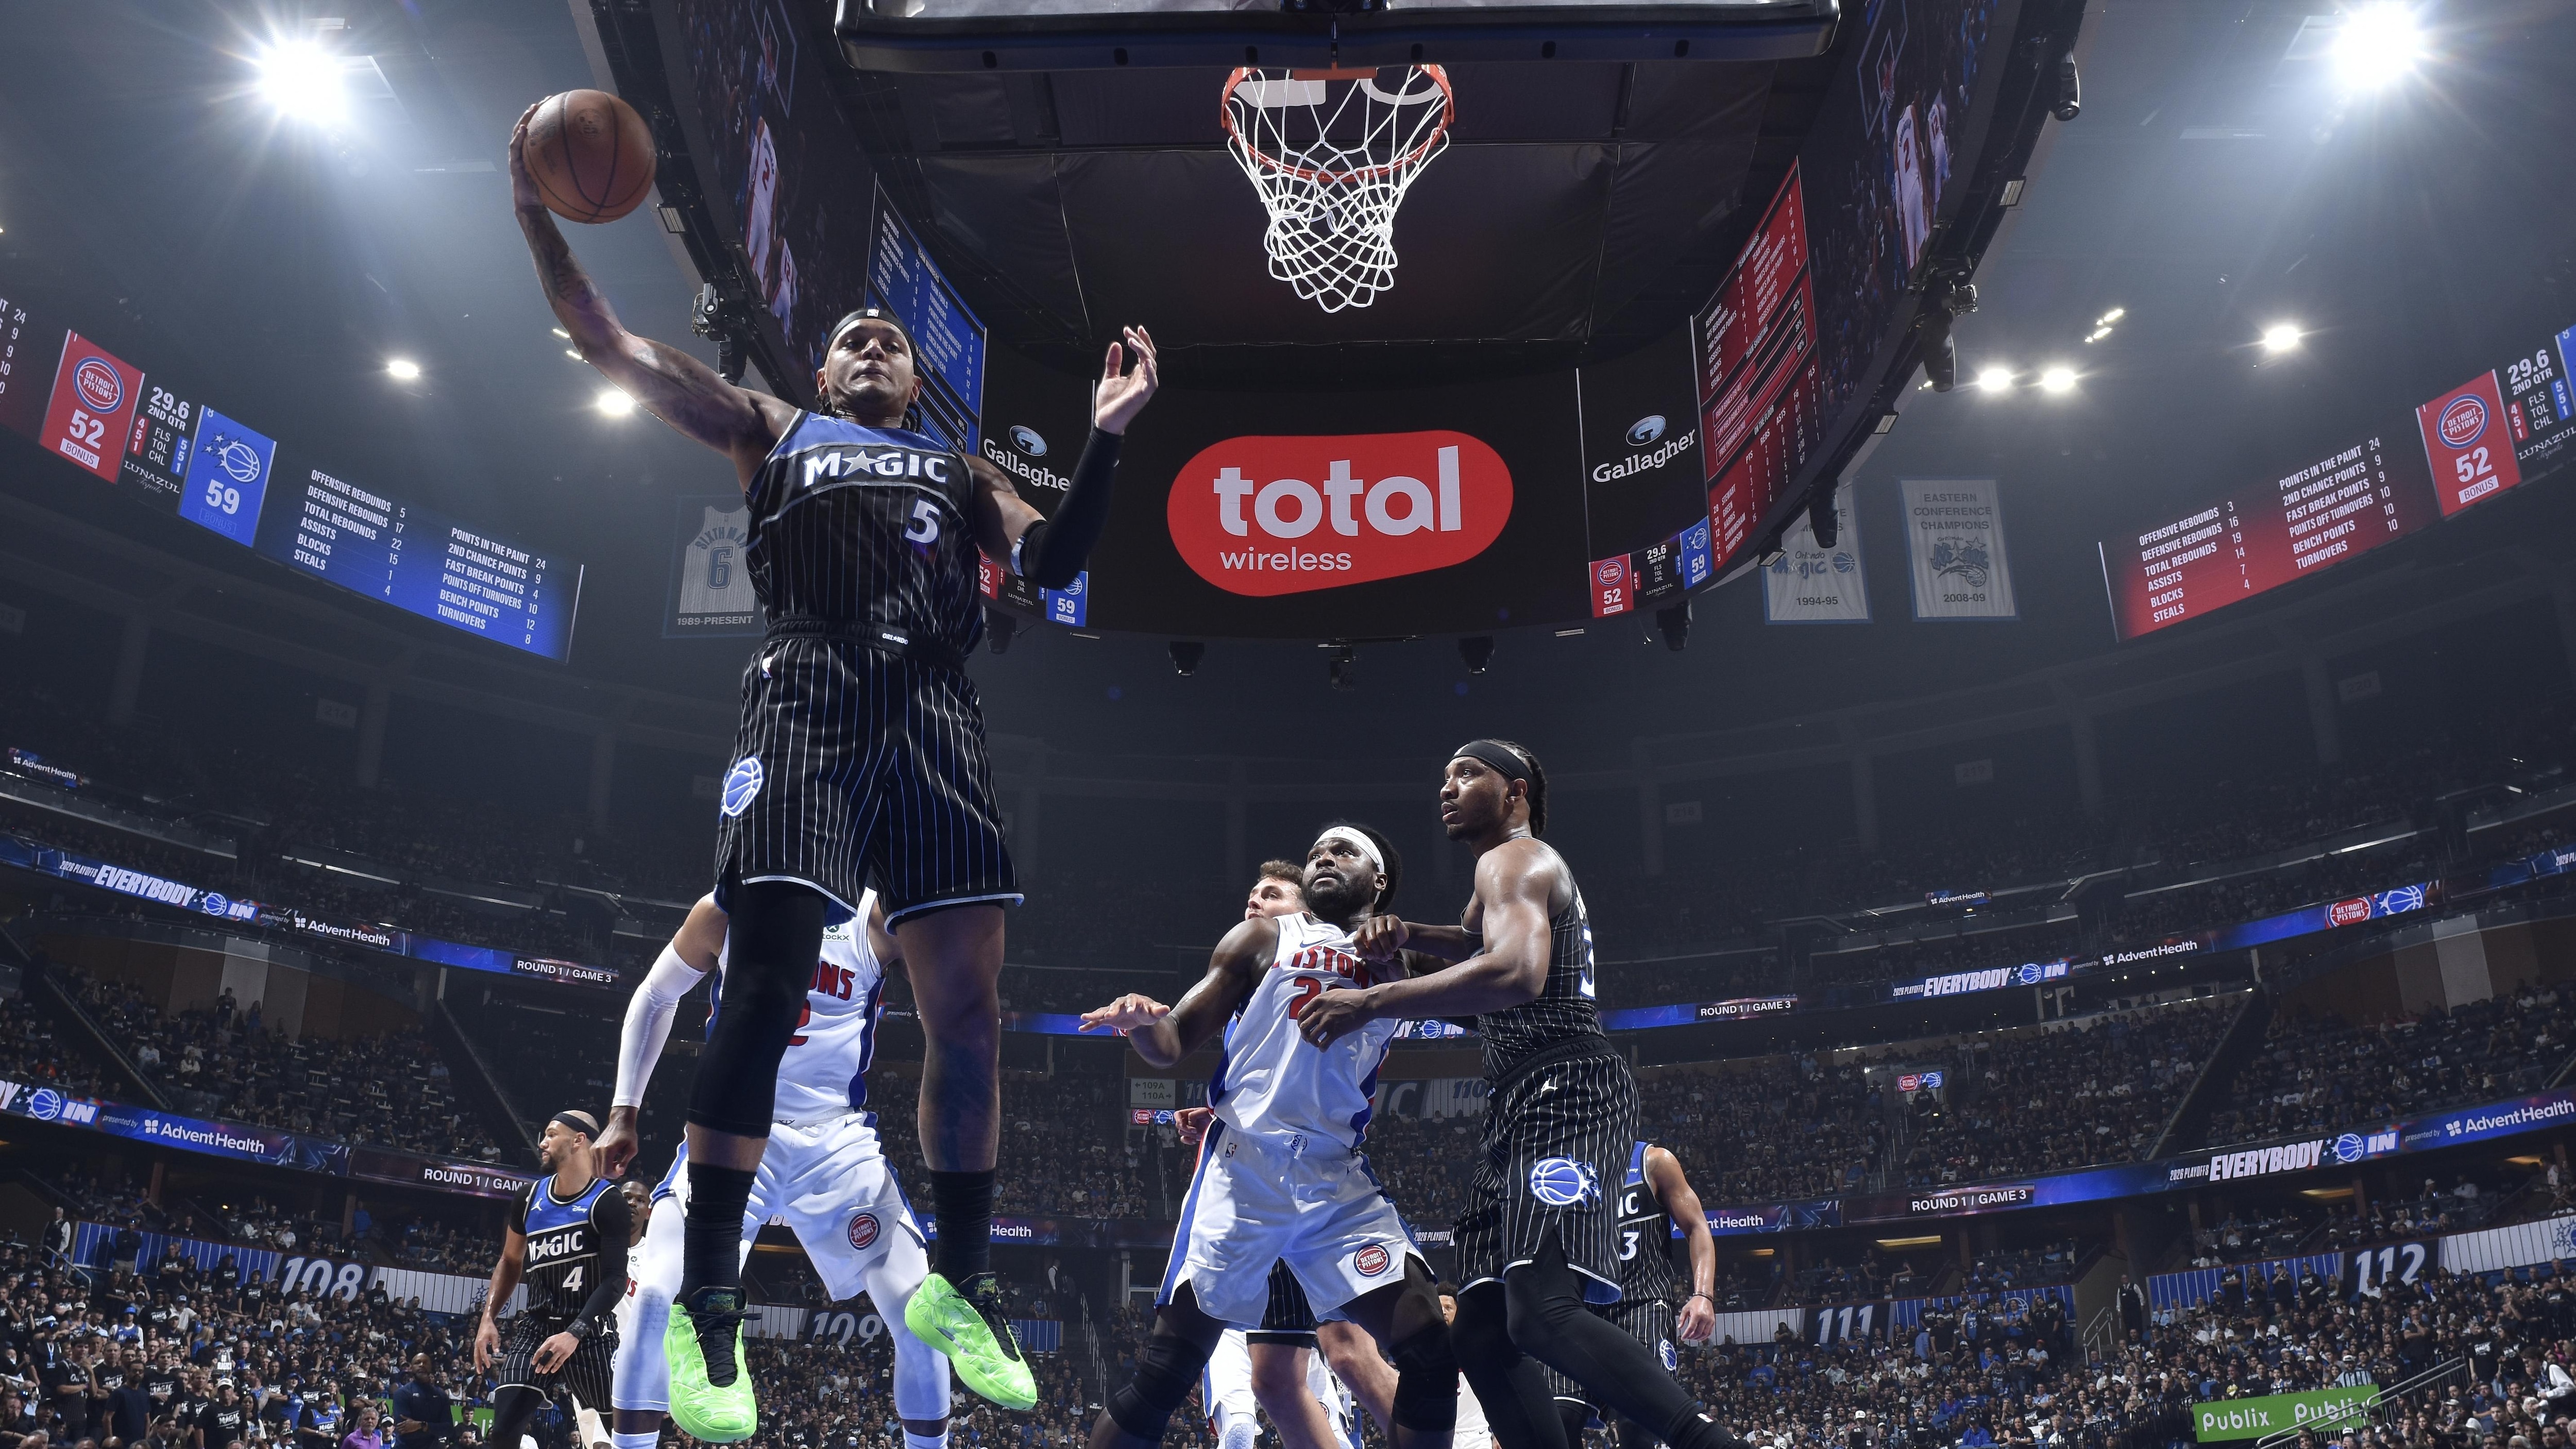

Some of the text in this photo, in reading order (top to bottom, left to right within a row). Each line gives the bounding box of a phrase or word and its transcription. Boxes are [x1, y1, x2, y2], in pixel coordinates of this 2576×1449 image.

[2508, 349, 2549, 384] 29.6
[83, 378, 112, 400] PISTONS
[86, 370, 114, 392] DETROIT
[2512, 368, 2552, 395] 2ND QTR
[150, 387, 190, 419] 29.6
[70, 409, 104, 449] 52
[148, 405, 185, 431] 2ND QTR
[2447, 408, 2476, 427] DETROIT
[2449, 415, 2479, 435] PISTONS
[153, 438, 167, 453] TOL
[155, 427, 171, 442] FLS
[65, 443, 94, 464] BONUS
[149, 450, 164, 465] CHL
[984, 438, 1071, 492] Gallaghe
[1592, 429, 1696, 483] Gallagher
[2456, 447, 2492, 482] 52
[124, 461, 181, 494] LUNAZUL
[1213, 445, 1461, 538] total
[2464, 479, 2494, 499] BONUS
[206, 479, 239, 514] 59
[311, 470, 405, 518] OFFENSIVE REBOUNDS 5
[308, 485, 404, 533] DEFENSIVE REBOUNDS 17
[904, 499, 940, 544] 5
[1914, 507, 1992, 516] CONFERENCE
[305, 501, 402, 550] TOTAL REBOUNDS 22
[1921, 521, 1989, 530] CHAMPIONS
[2139, 501, 2233, 546] OFFENSIVE REBOUNDS 3
[301, 517, 398, 565] ASSISTS 15
[451, 528, 546, 569] POINTS IN THE PAINT 24
[2142, 516, 2239, 561] DEFENSIVE REBOUNDS 16
[297, 533, 392, 580] BLOCKS 1
[448, 543, 541, 584] 2ND CHANCE POINTS 9
[708, 547, 733, 589] 6
[1220, 546, 1352, 571] wireless
[1692, 554, 1704, 573] 59
[2144, 532, 2241, 577] TOTAL REBOUNDS 19
[294, 549, 391, 596] STEALS 4
[446, 559, 538, 599] FAST BREAK POINTS 4
[2148, 547, 2245, 592] ASSISTS 14
[443, 573, 537, 614] POINTS OFF TURNOVERS 10
[1604, 588, 1621, 604] 52
[1944, 594, 1986, 603] 2008-09
[2150, 564, 2245, 608] BLOCKS 7
[440, 589, 535, 630] BENCH POINTS 12
[1796, 597, 1838, 605] 1994-95
[2154, 579, 2249, 622] STEALS 4
[438, 604, 531, 644] TURNOVERS 8
[677, 616, 753, 626] 1989-PRESENT
[22, 760, 76, 780] AdventHealth
[59, 861, 255, 918] 2026 PLAYOFFS EVERYBODY IN
[1939, 891, 1985, 903] AdventHealth
[2336, 902, 2363, 914] DETROIT
[2337, 909, 2365, 921] PISTONS
[308, 920, 389, 946] AdventHealth
[2117, 940, 2197, 963] AdventHealth
[517, 961, 555, 973] ROUND
[572, 969, 603, 981] GAME
[1893, 963, 2066, 997] 2026 PLAYOFFS EVERYBODY IN
[1701, 1006, 1737, 1016] ROUND
[1753, 1001, 1783, 1011] GAME
[62, 1102, 96, 1122] IN
[2466, 1100, 2574, 1133] AdventHealth
[161, 1123, 264, 1153] AdventHealth
[2170, 1133, 2396, 1181] 2026 PLAYOFFS EVERYBODY IN
[1912, 1198, 1958, 1211] ROUND
[1961, 1197, 1966, 1206] 1
[1978, 1190, 2016, 1204] GAME
[2019, 1189, 2026, 1199] 3
[853, 1222, 871, 1236] DETROIT
[854, 1227, 873, 1241] PISTONS
[990, 1224, 1031, 1237] Health
[1360, 1252, 1381, 1263] DETROIT
[1362, 1256, 1384, 1268] PISTONS
[282, 1257, 363, 1301] 108
[563, 1266, 583, 1291] 4
[1818, 1305, 1872, 1343] 111
[2202, 1408, 2270, 1432] Publix
